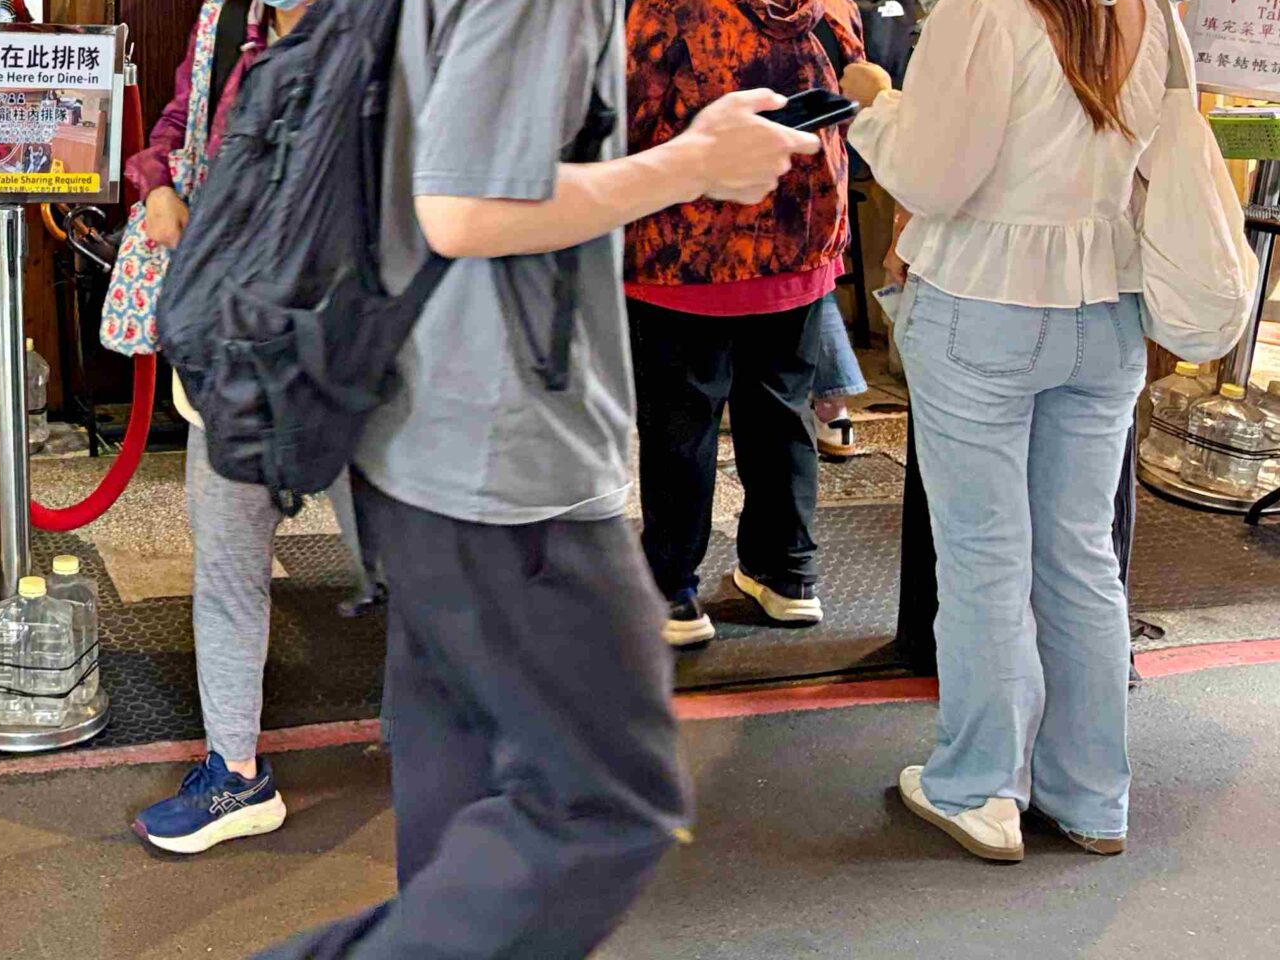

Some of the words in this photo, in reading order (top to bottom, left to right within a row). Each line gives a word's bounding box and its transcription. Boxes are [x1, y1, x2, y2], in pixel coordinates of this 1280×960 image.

[1202, 16, 1280, 37] 填完菜單
[7, 72, 35, 83] Here
[38, 72, 55, 83] for
[57, 72, 99, 84] Dine-in
[20, 175, 53, 186] Sharing
[55, 176, 92, 186] Required
